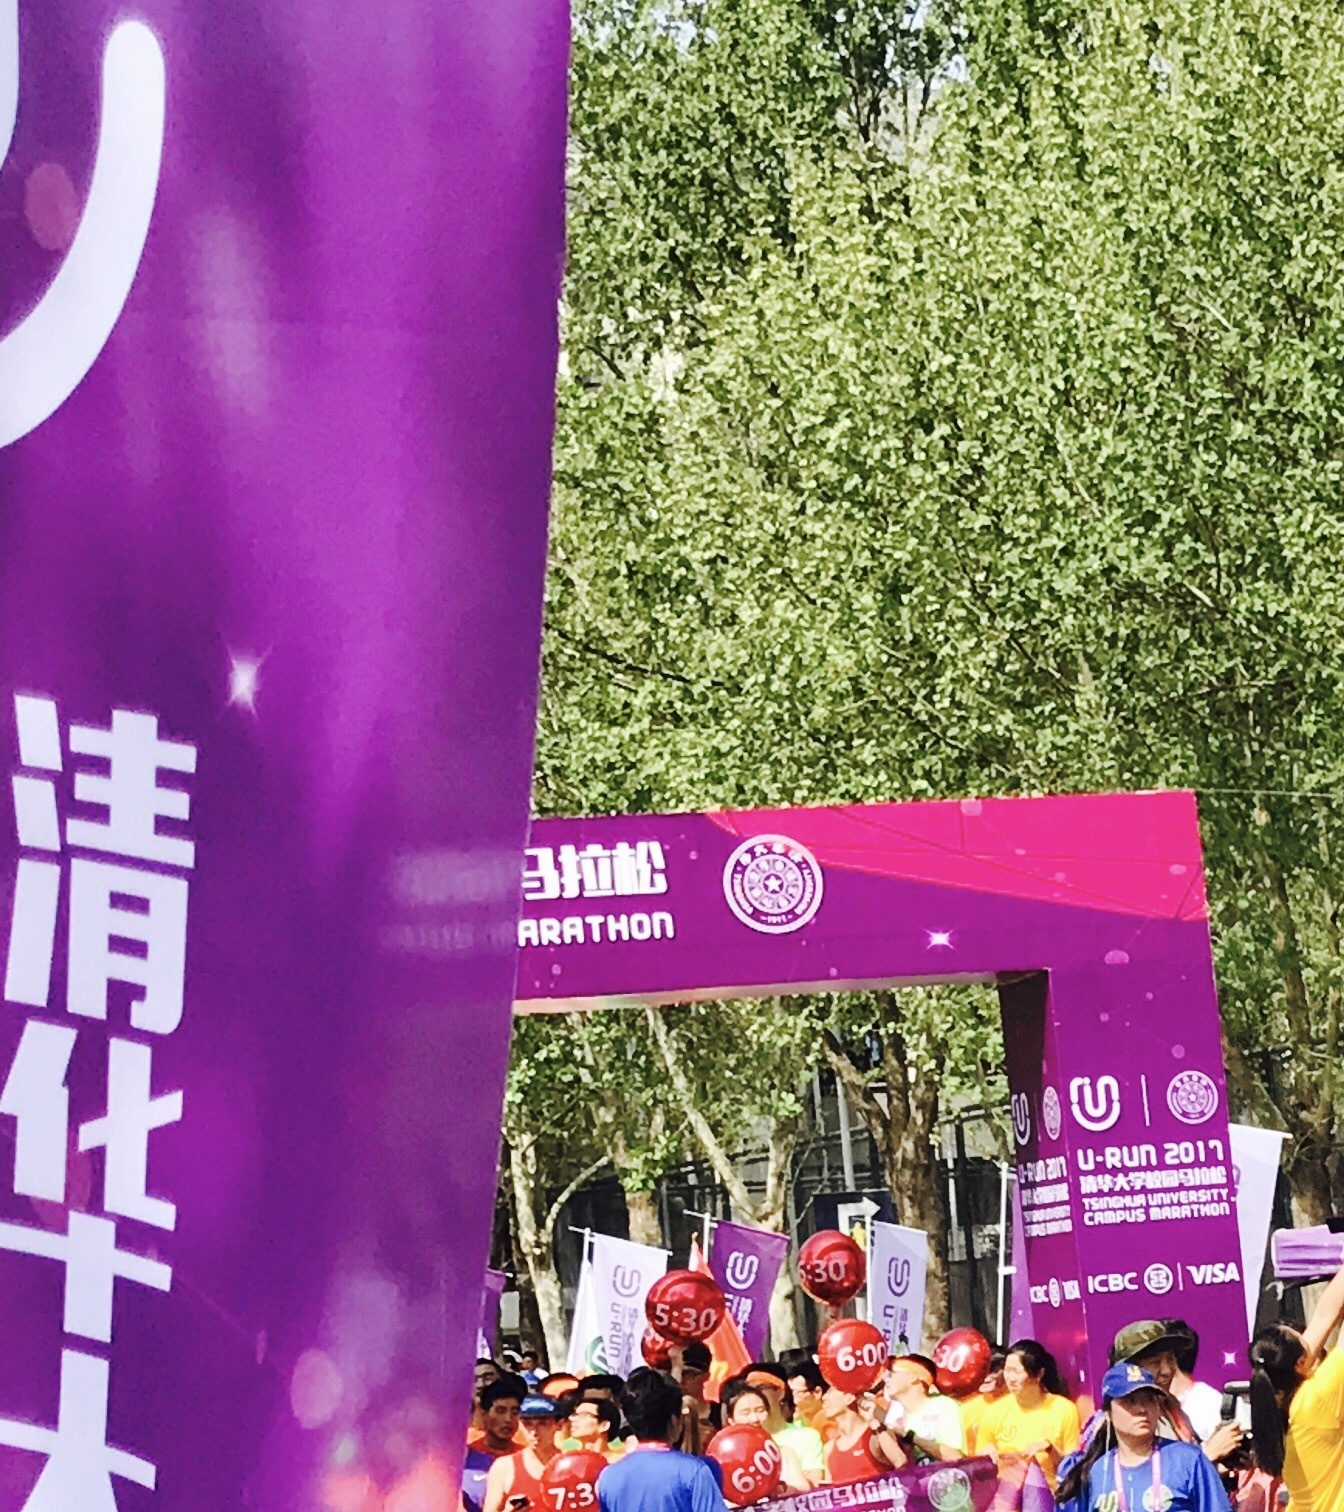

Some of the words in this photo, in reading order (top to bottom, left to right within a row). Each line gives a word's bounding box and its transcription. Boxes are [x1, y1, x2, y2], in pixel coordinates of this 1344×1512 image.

[521, 841, 668, 901] 马拉松
[517, 911, 675, 947] ARATHON
[1077, 1144, 1157, 1171] U-RUN
[1163, 1139, 1224, 1166] 2017
[1082, 1197, 1147, 1210] TSINGHUA
[1148, 1188, 1228, 1205] UNIVERSITY
[1083, 1209, 1146, 1226] CAMPUS
[1149, 1202, 1230, 1220] MARATHON
[1087, 1272, 1139, 1294] ICBC
[1186, 1262, 1241, 1285] VISA
[655, 1303, 718, 1333] 5:30
[836, 1341, 889, 1372] 6:00
[732, 1438, 781, 1494] 6:00
[548, 1481, 595, 1511] 7:3
